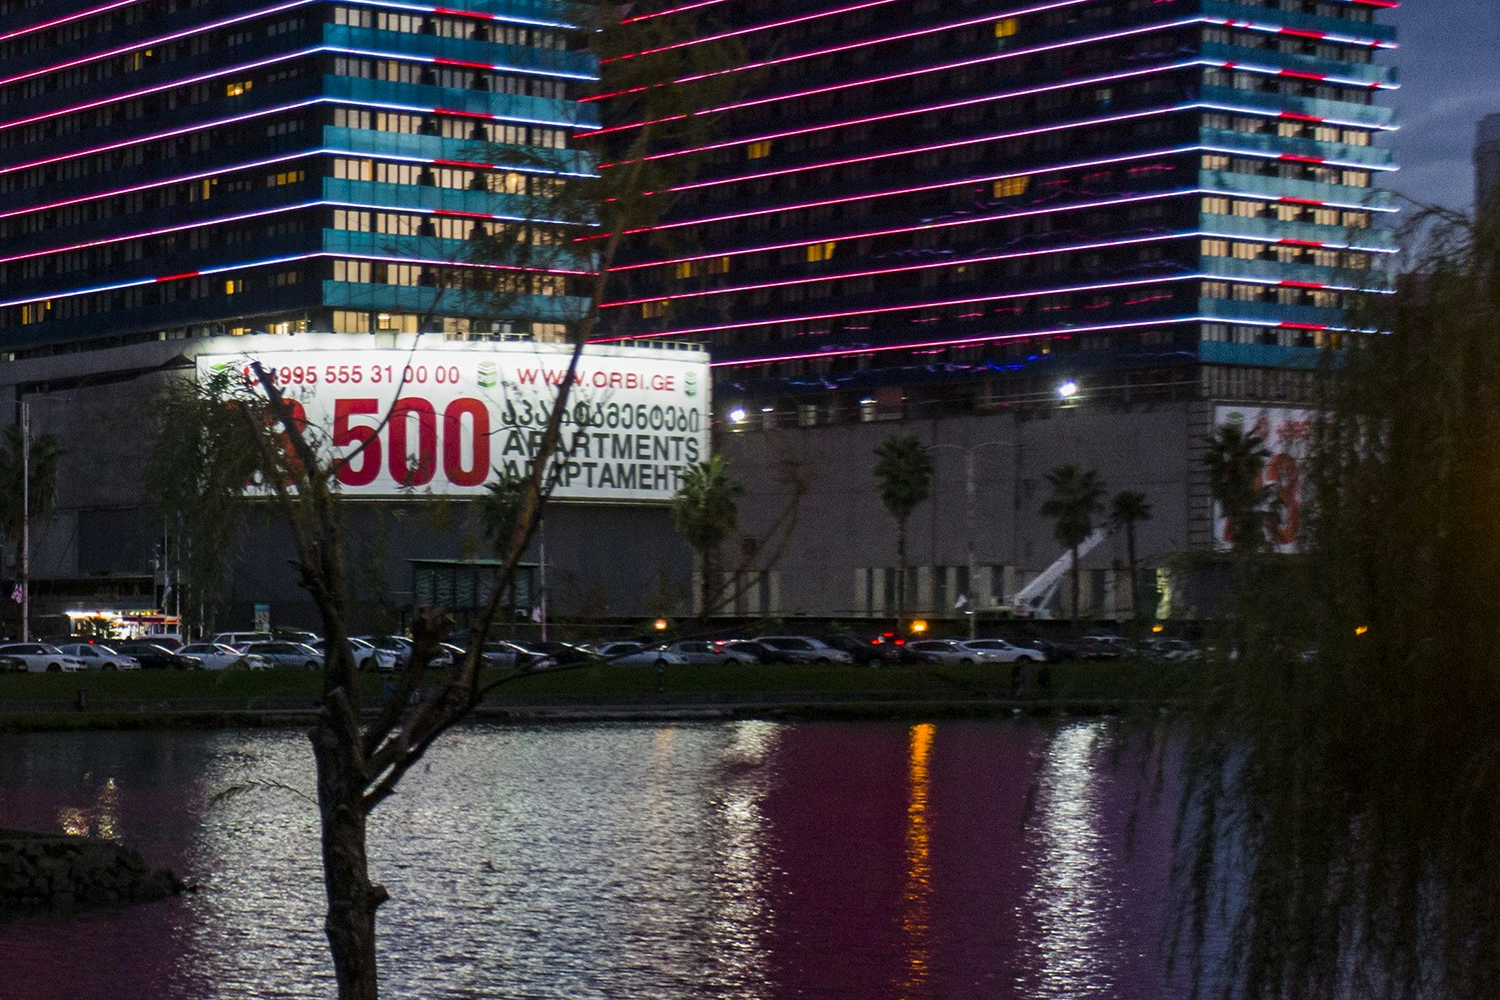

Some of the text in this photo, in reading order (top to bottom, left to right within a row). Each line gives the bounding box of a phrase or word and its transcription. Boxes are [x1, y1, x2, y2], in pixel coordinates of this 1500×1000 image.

[325, 365, 362, 384] 555
[371, 366, 393, 384] 31
[404, 366, 427, 384] 00
[435, 366, 460, 385] 00
[332, 396, 490, 487] 500
[502, 430, 699, 462] APARTMENTS
